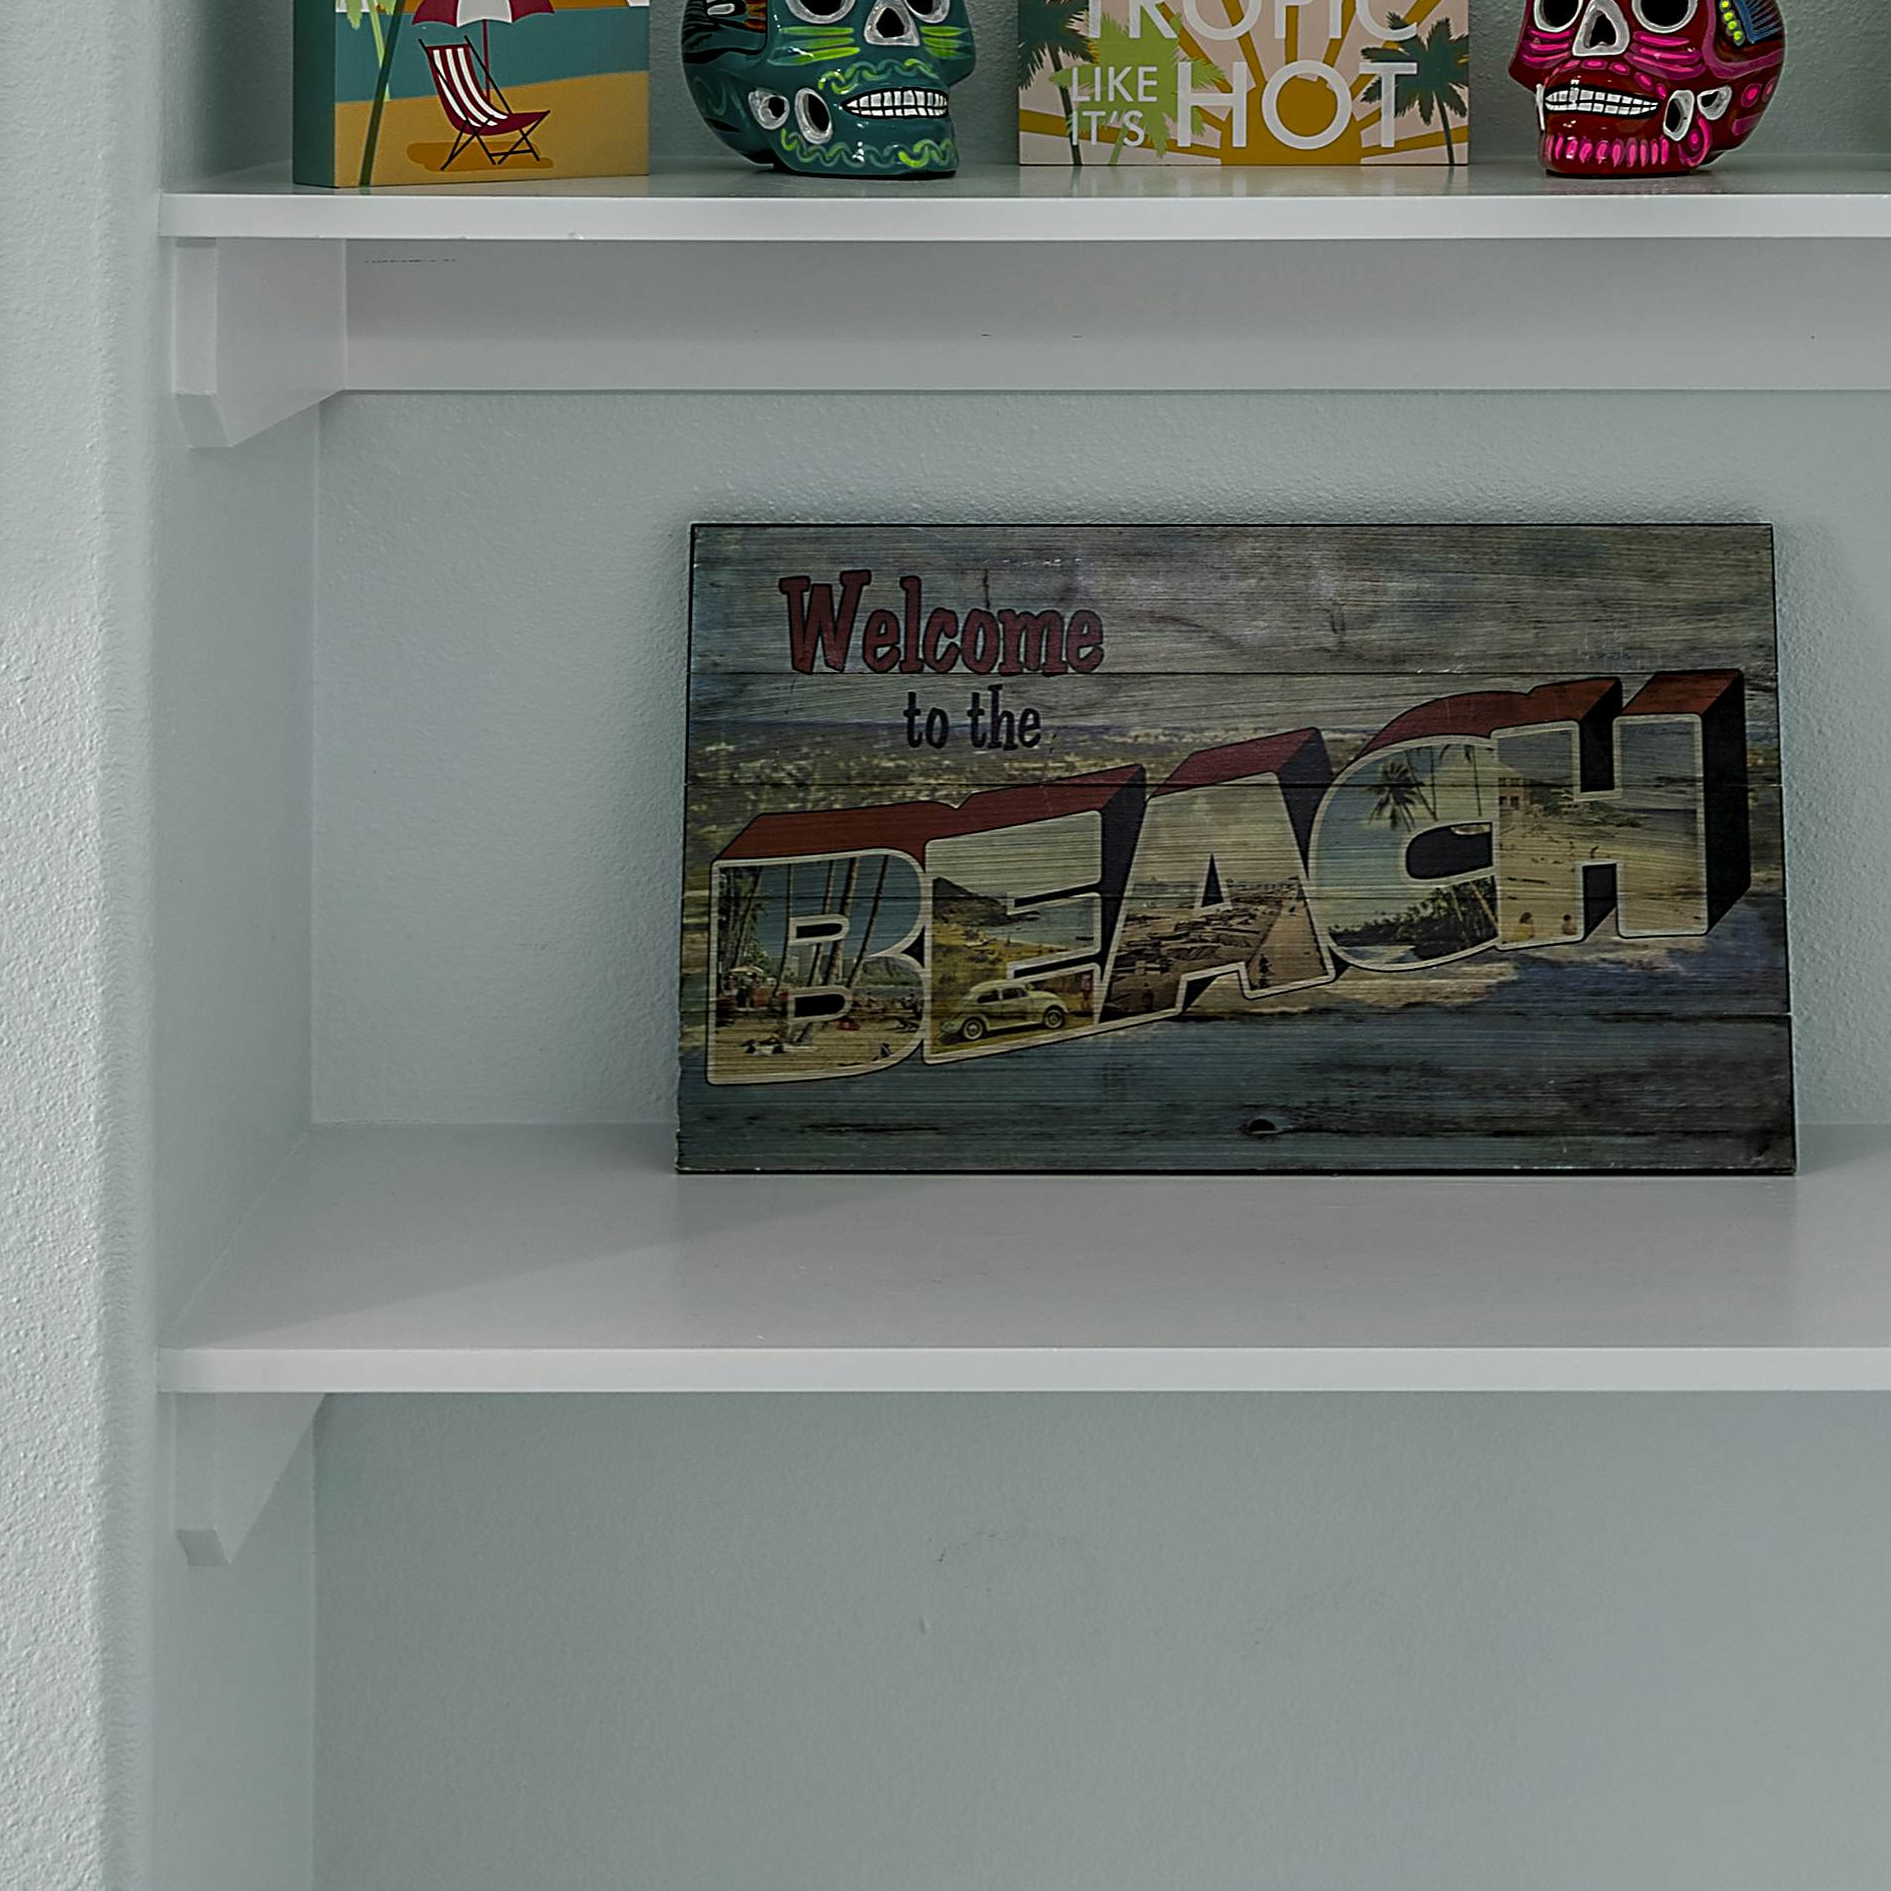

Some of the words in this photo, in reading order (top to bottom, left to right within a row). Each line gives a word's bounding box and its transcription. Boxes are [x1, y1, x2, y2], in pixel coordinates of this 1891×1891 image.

[1071, 65, 1159, 103] LIKE
[1176, 59, 1418, 150] HOT
[1071, 109, 1146, 148] IT'S
[777, 566, 1105, 677] Welcome
[902, 691, 951, 749] to
[966, 682, 1043, 750] the
[704, 671, 1750, 1086] BEACH
